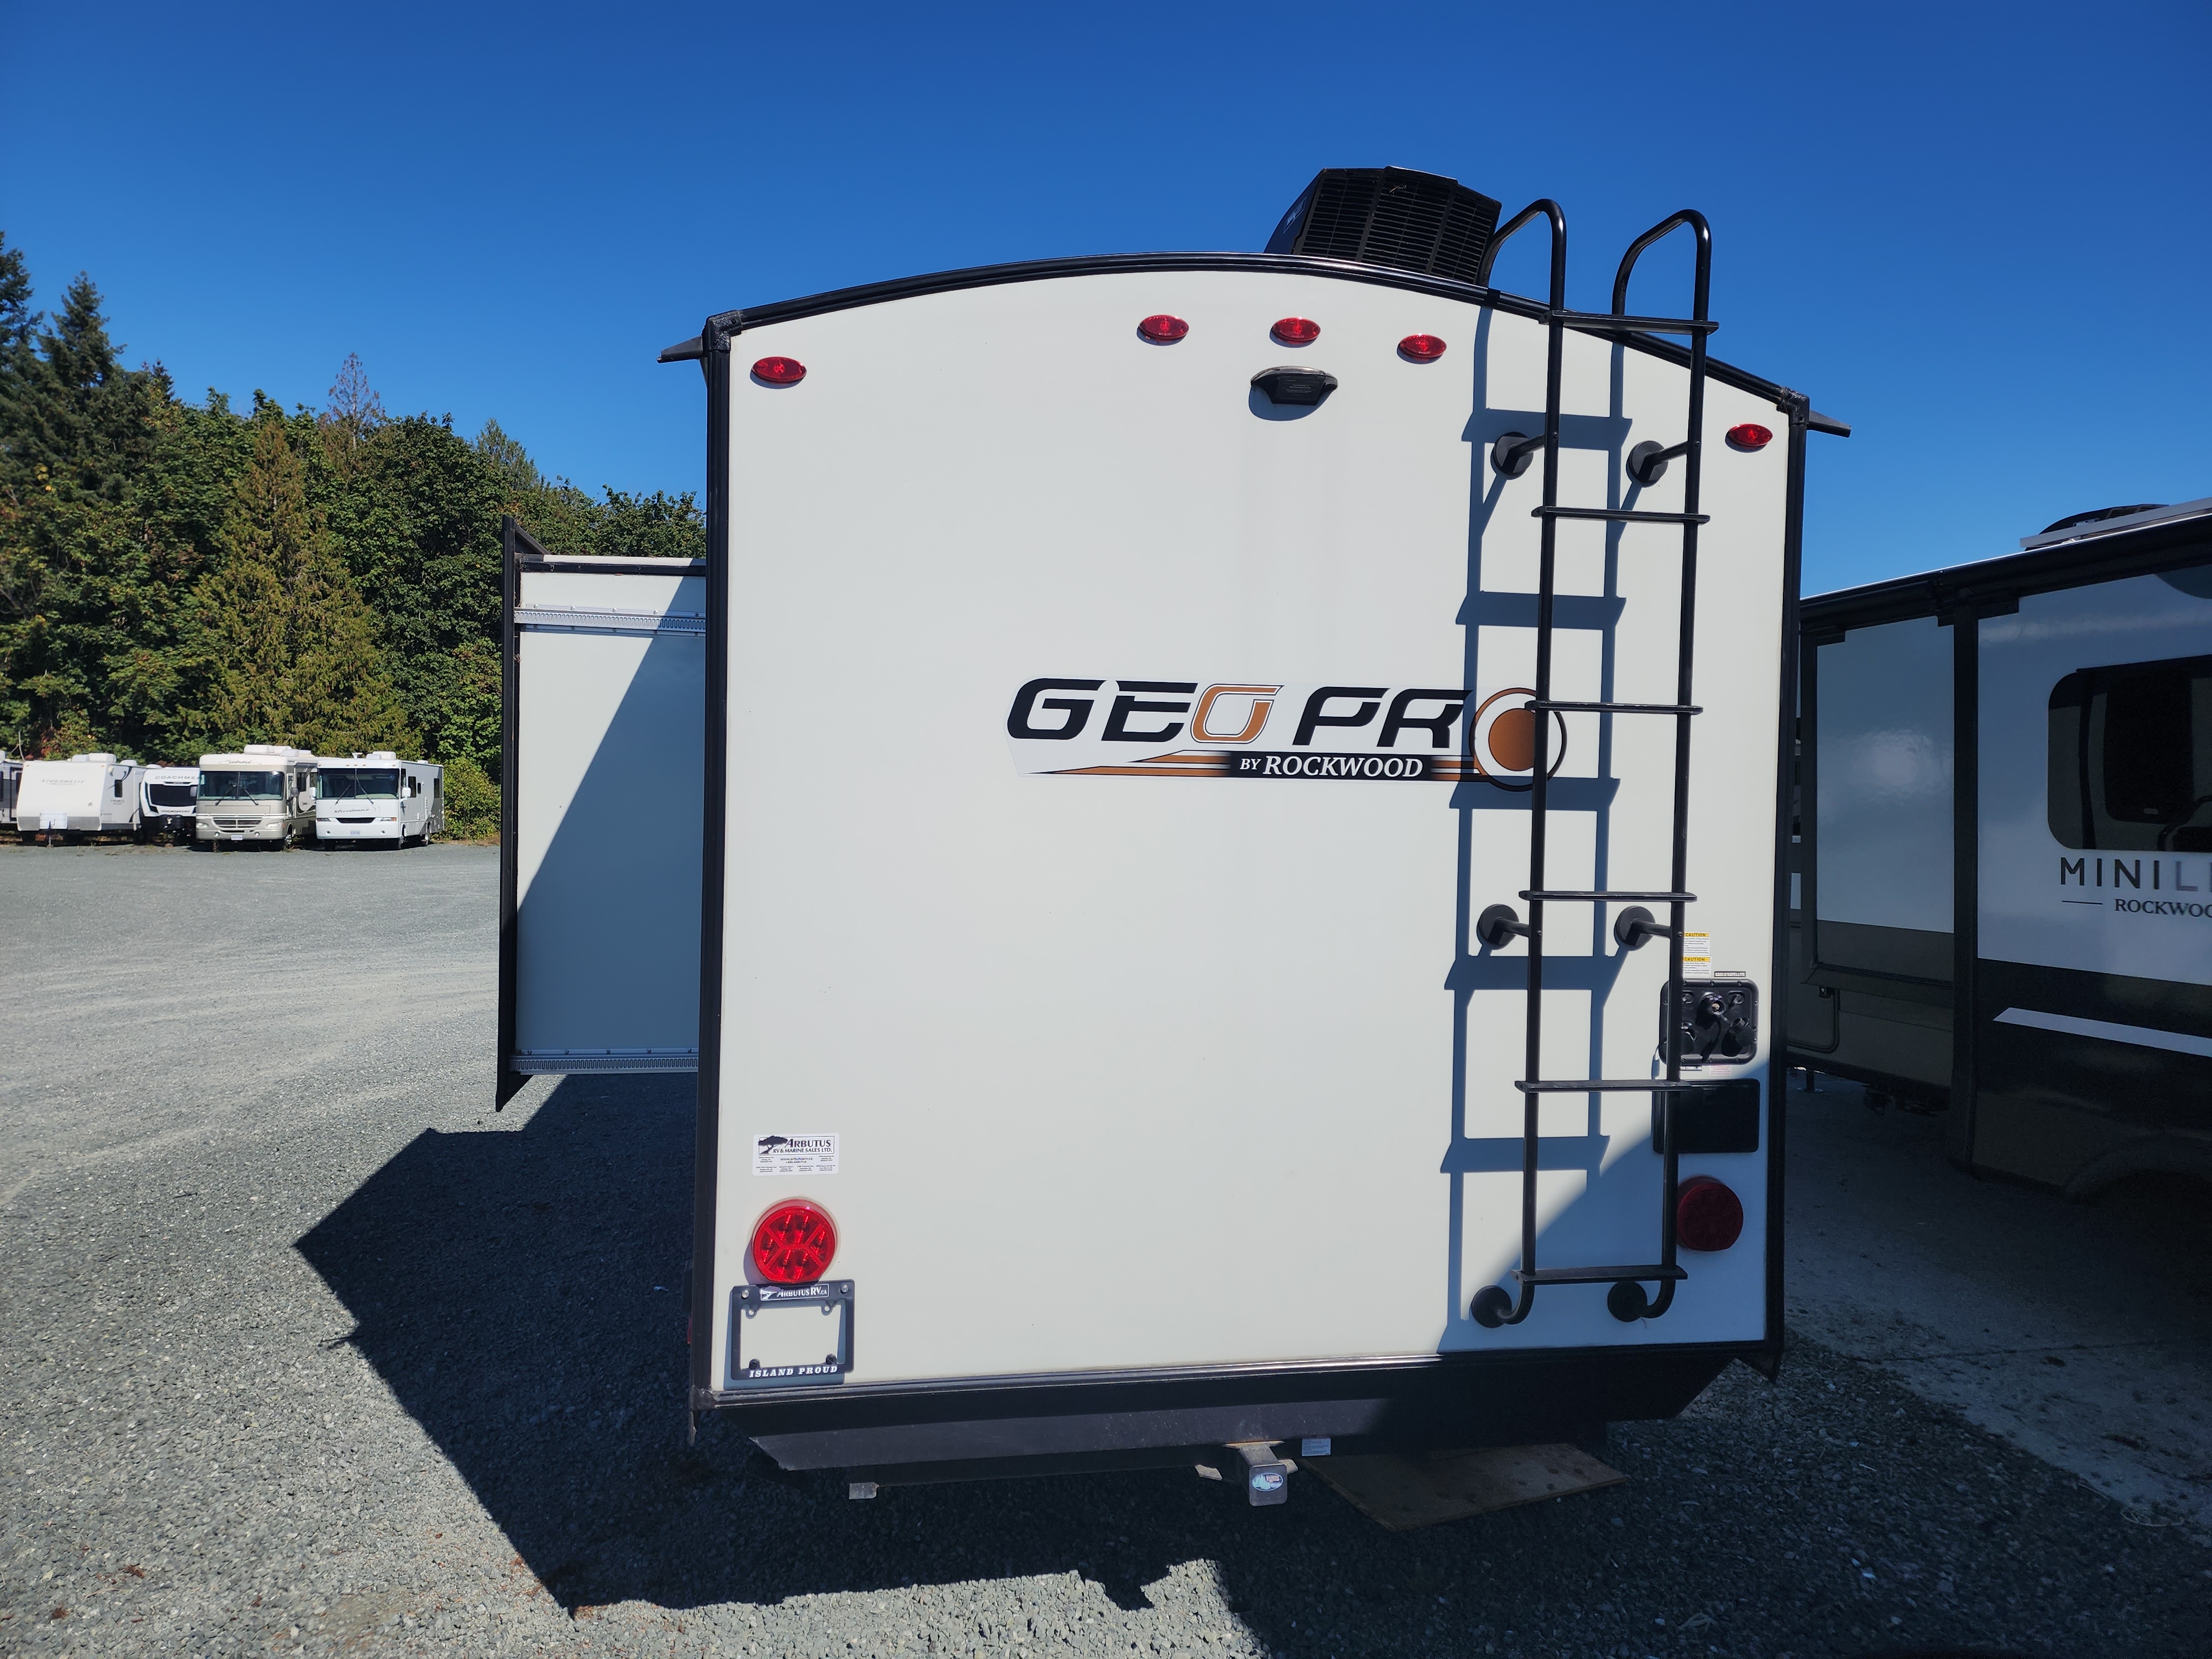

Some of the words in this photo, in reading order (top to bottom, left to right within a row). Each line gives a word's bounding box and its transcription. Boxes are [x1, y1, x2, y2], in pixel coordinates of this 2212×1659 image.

[1006, 677, 1284, 745] GEO
[1291, 686, 1567, 792] PRO
[1239, 757, 1261, 771] BY
[1262, 755, 1423, 779] ROCKWOOD
[784, 1139, 831, 1148] ARBUTUS
[749, 1369, 794, 1378] ISLAND
[798, 1366, 838, 1375] PROUD
